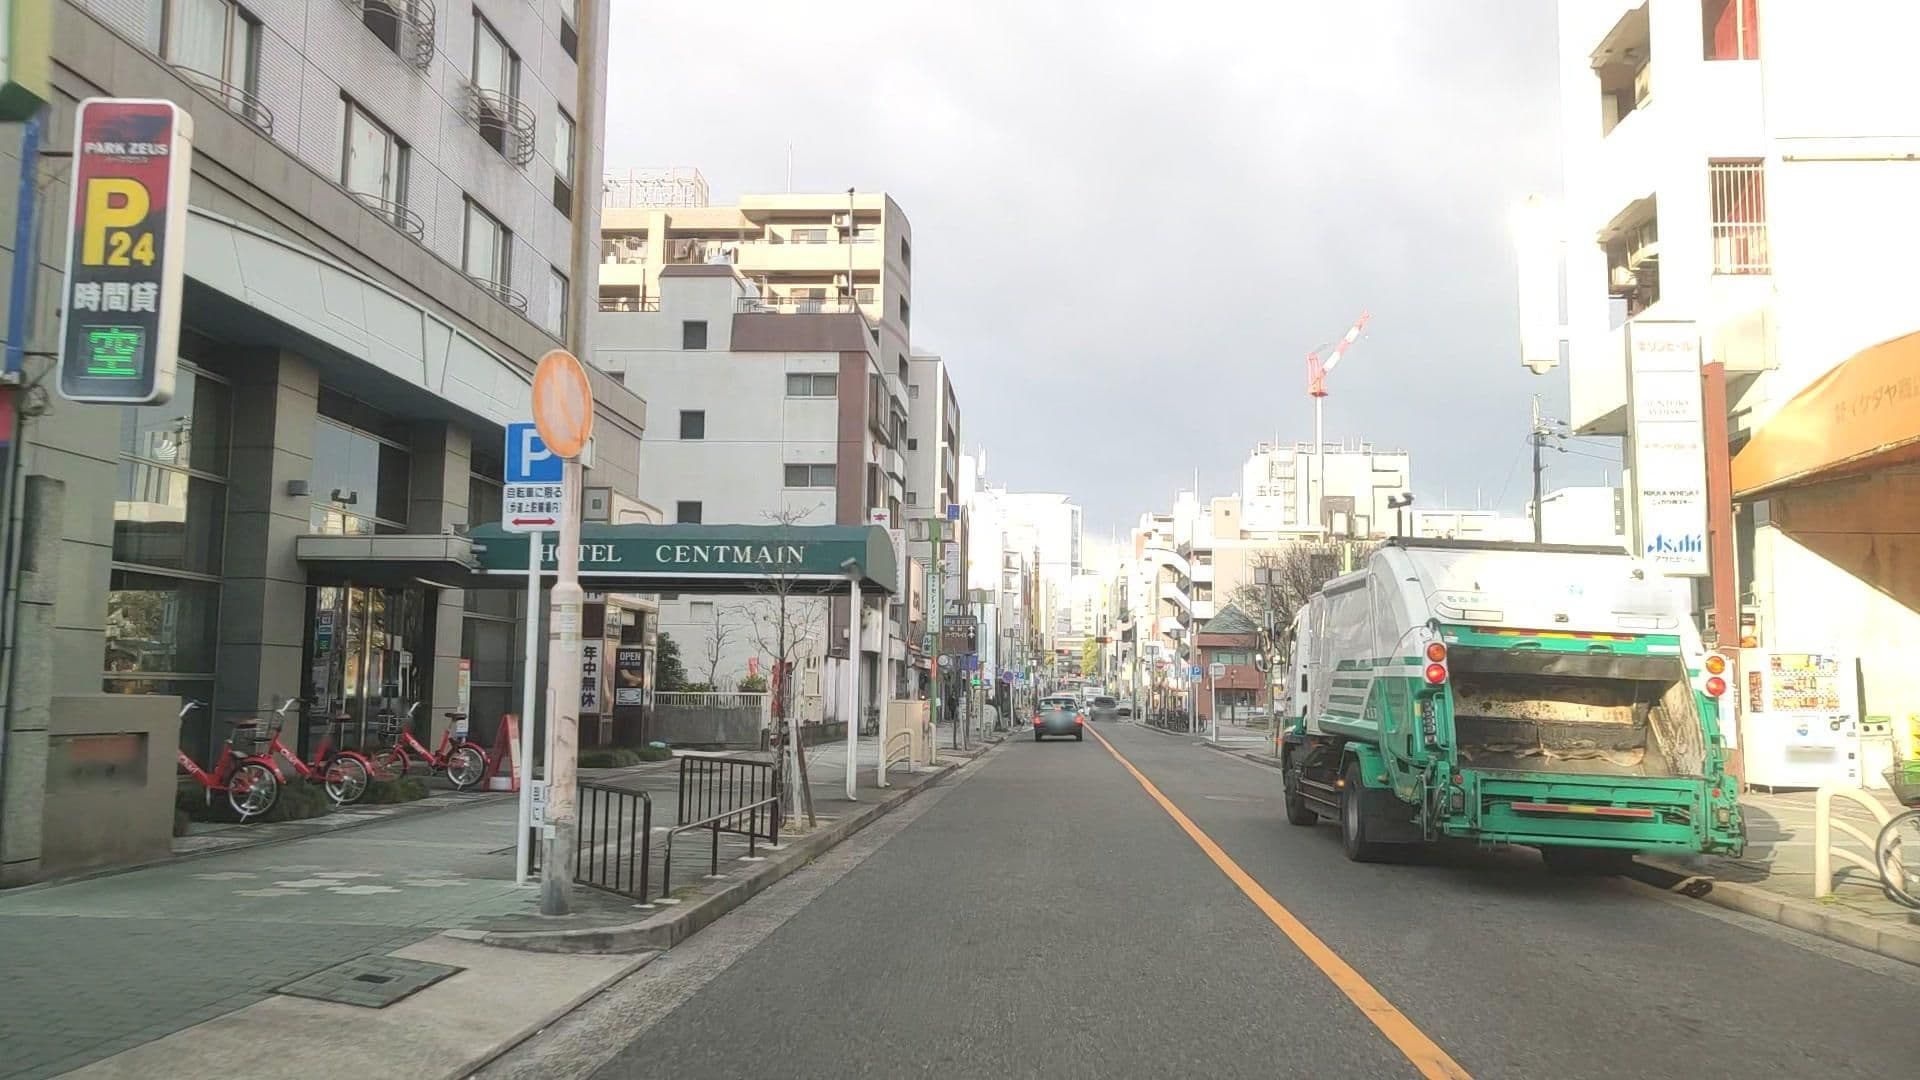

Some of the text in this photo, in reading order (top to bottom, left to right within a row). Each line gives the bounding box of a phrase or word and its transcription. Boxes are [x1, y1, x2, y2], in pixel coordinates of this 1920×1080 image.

[84, 142, 168, 155] PARK ZEUS
[74, 281, 159, 313] 時間貸
[87, 327, 140, 375] 空
[519, 428, 553, 476] P
[655, 545, 804, 564] CENTMAIN
[1647, 534, 1702, 553] Asahi
[619, 652, 641, 661] OPEN
[582, 646, 597, 707] 年中無休
